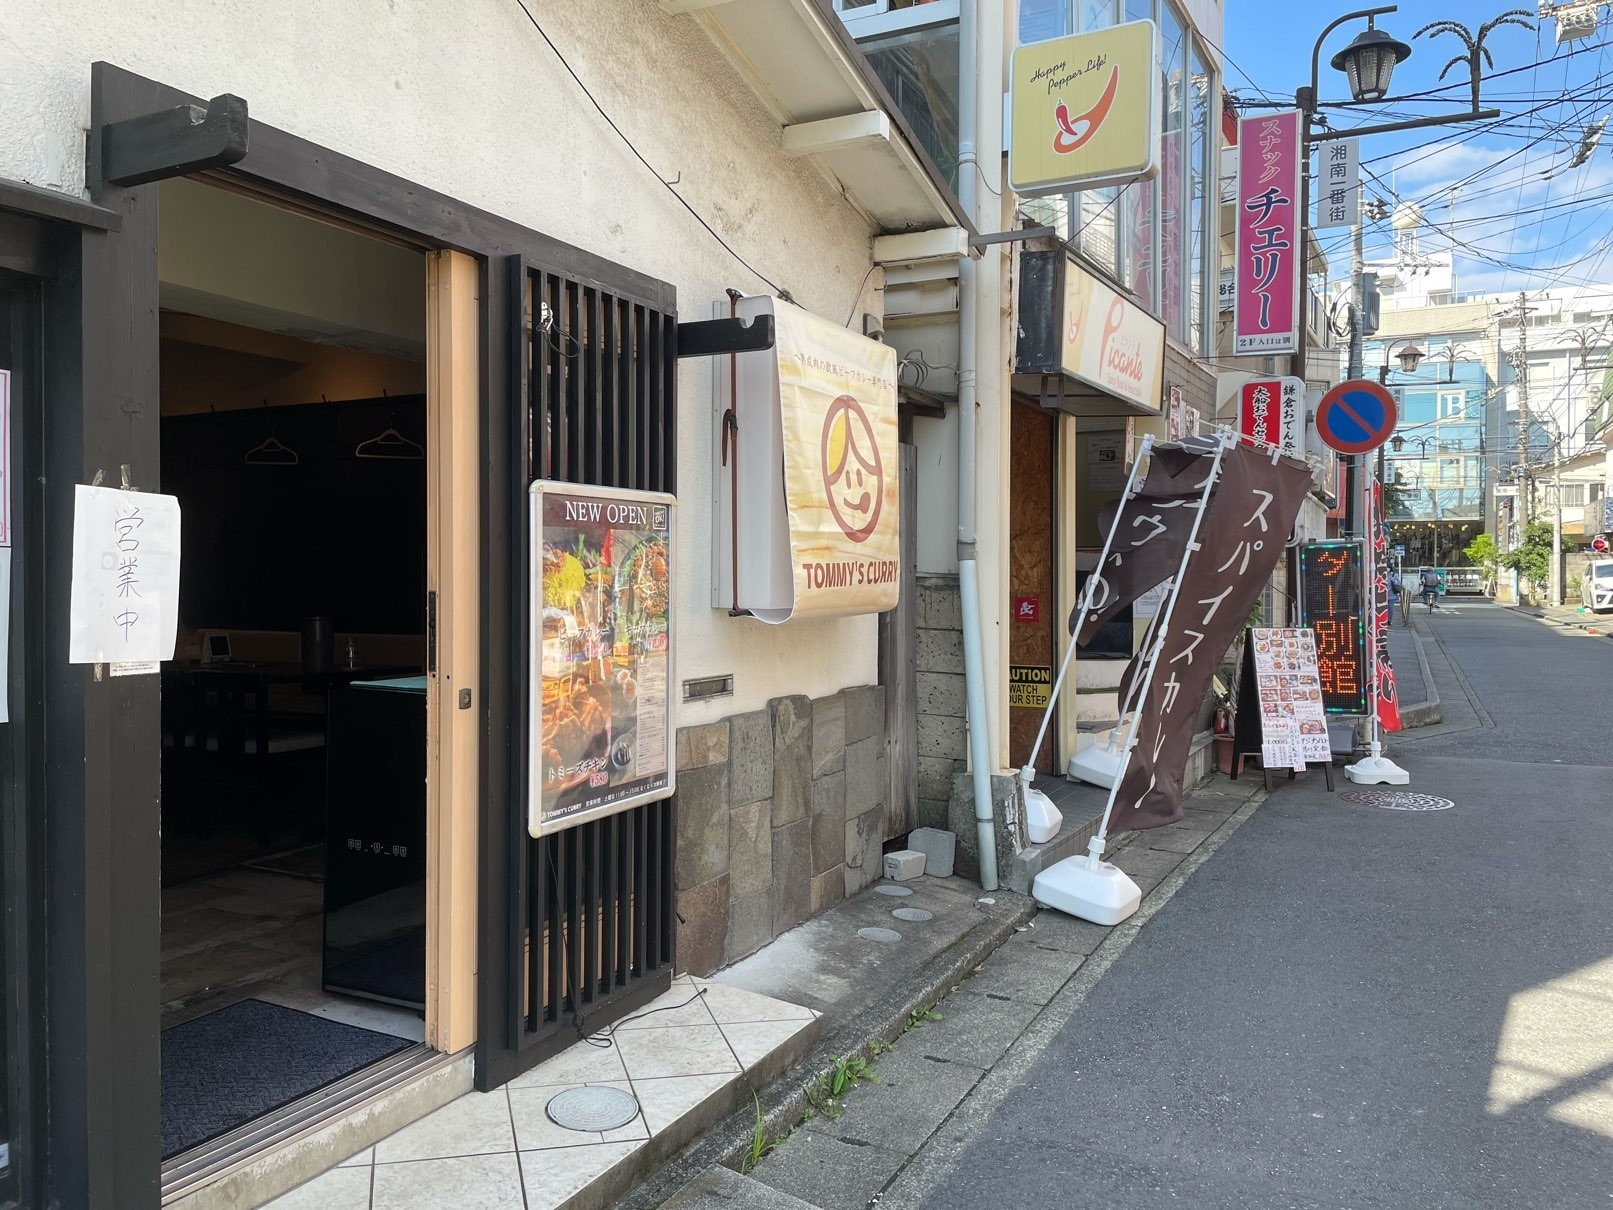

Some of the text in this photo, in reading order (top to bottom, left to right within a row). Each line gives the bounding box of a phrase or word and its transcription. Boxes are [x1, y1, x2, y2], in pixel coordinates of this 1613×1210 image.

[1030, 60, 1066, 82] Happy
[1047, 54, 1107, 95] Pepper Life!
[1258, 119, 1283, 185] スナック
[1328, 144, 1348, 222] 湘南一番街
[1244, 186, 1291, 330] チェリー
[1098, 294, 1144, 382] Picante
[565, 500, 647, 525] NEW OPEN
[112, 506, 146, 644] 営業中
[802, 559, 899, 590] TOMMY'S CURRY
[1134, 489, 1274, 810] スパイスカレー
[1026, 695, 1047, 706] STEP
[548, 757, 609, 783] トミーズチキン
[547, 803, 583, 818] TOMMY'S CURRY
